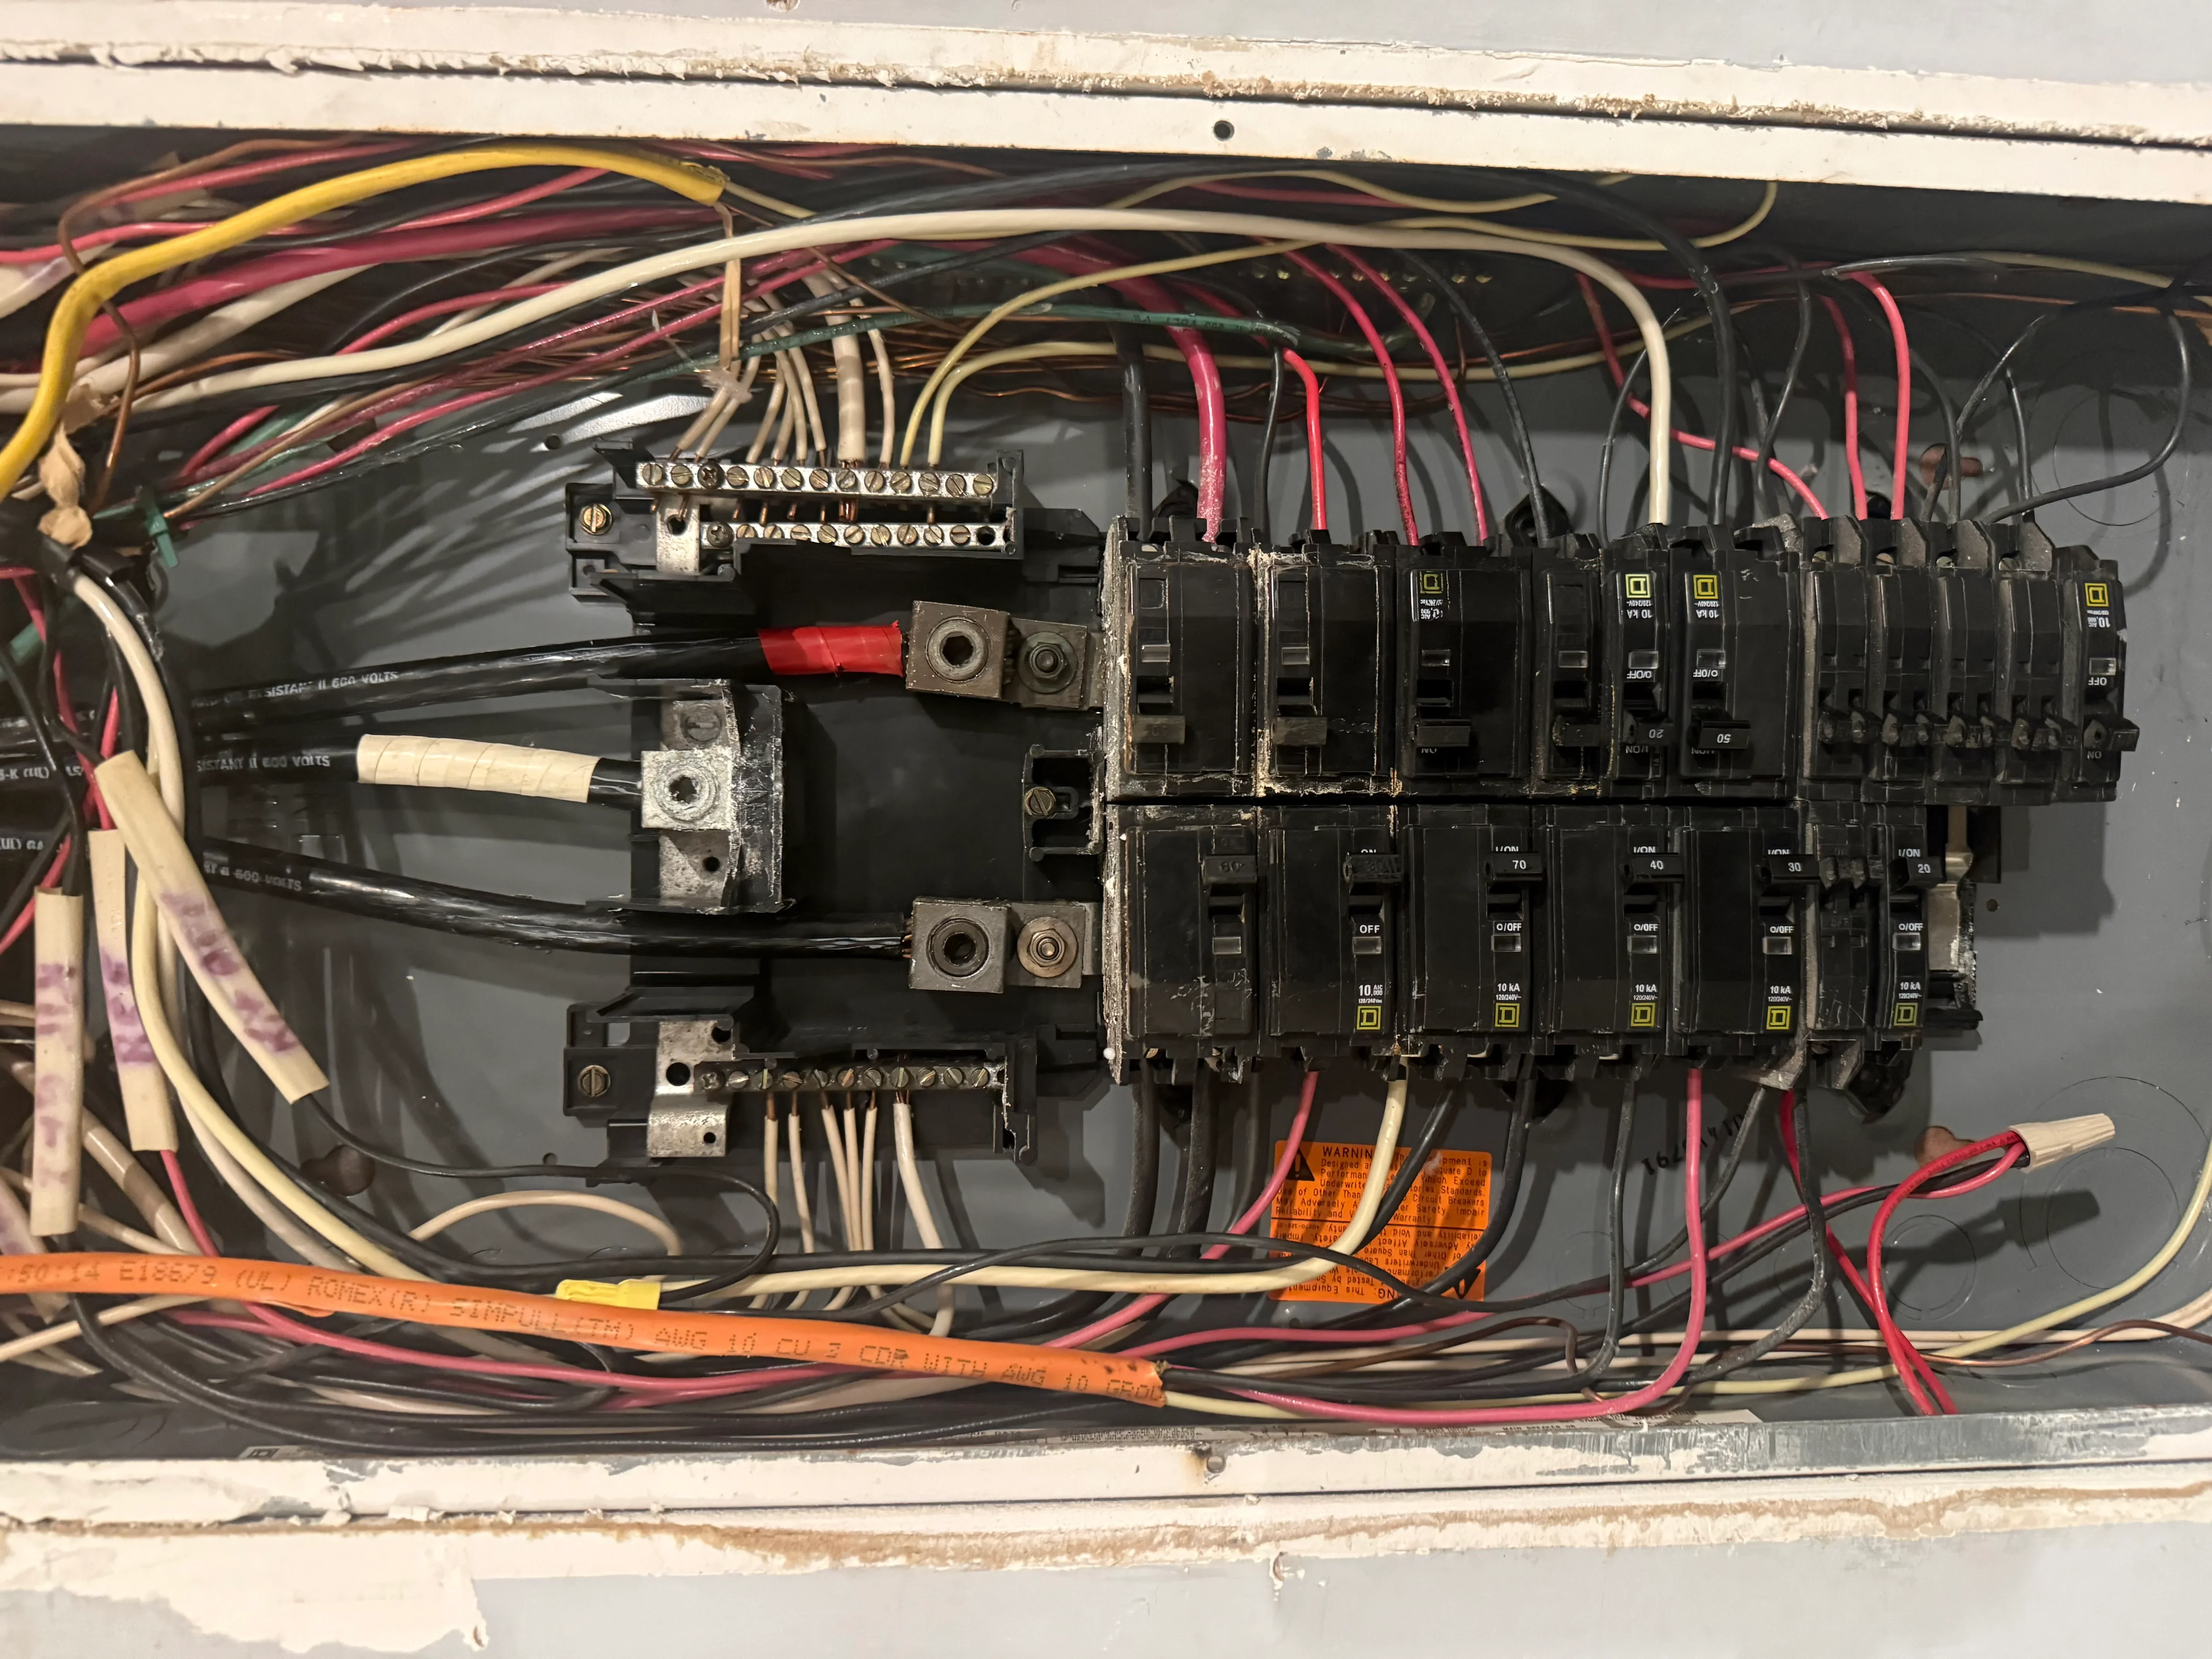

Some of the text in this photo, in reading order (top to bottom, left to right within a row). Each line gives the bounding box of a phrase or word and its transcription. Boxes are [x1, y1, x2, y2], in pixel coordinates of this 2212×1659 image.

[1627, 610, 1653, 618] 10 kA
[1696, 610, 1719, 618] 10 kA
[361, 672, 400, 684] VOLTS
[2088, 678, 2107, 686] OFF
[1649, 729, 1664, 738] 20
[1717, 734, 1731, 743] 50
[2087, 751, 2102, 759] ON
[292, 755, 330, 767] VOLTS
[1512, 860, 1527, 869] 70
[1650, 860, 1664, 870] 40
[1788, 862, 1802, 872] 30
[1918, 864, 1931, 874] 20
[1359, 925, 1380, 933] OFF
[1497, 983, 1520, 992] 10 kA
[1635, 984, 1657, 993] 10 kA
[1770, 986, 1791, 994] 10 kA
[1900, 982, 1921, 990] 10 kA
[1322, 1146, 1374, 1159] WARNIN
[1321, 1159, 1359, 1170] Designed
[1439, 1166, 1461, 1176] quare
[1321, 1168, 1367, 1179] Performan
[1320, 1179, 1365, 1190] Underwrite
[1298, 1187, 1308, 1196] of
[1313, 1188, 1336, 1197] Other
[1343, 1189, 1361, 1199] Than
[1448, 1196, 1484, 1207] Breakers
[1276, 1206, 1321, 1218] Reliability
[1329, 1210, 1343, 1218] and
[1300, 1198, 1346, 1209] Adversely
[1456, 1206, 1485, 1217] Impair
[1393, 1228, 1411, 1238] Void
[1438, 1229, 1479, 1240] eliability
[1385, 1261, 1440, 1269] Underwriters
[1345, 1286, 1365, 1295] This
[235, 1269, 292, 1291] (UL)
[654, 1327, 708, 1351] AWG
[727, 1332, 757, 1354] 10
[776, 1338, 812, 1356] CU
[923, 1353, 988, 1378] WITH
[1000, 1365, 1047, 1386] AWG
[1063, 1373, 1089, 1392] 10
[1105, 1379, 1163, 1402] GROU
